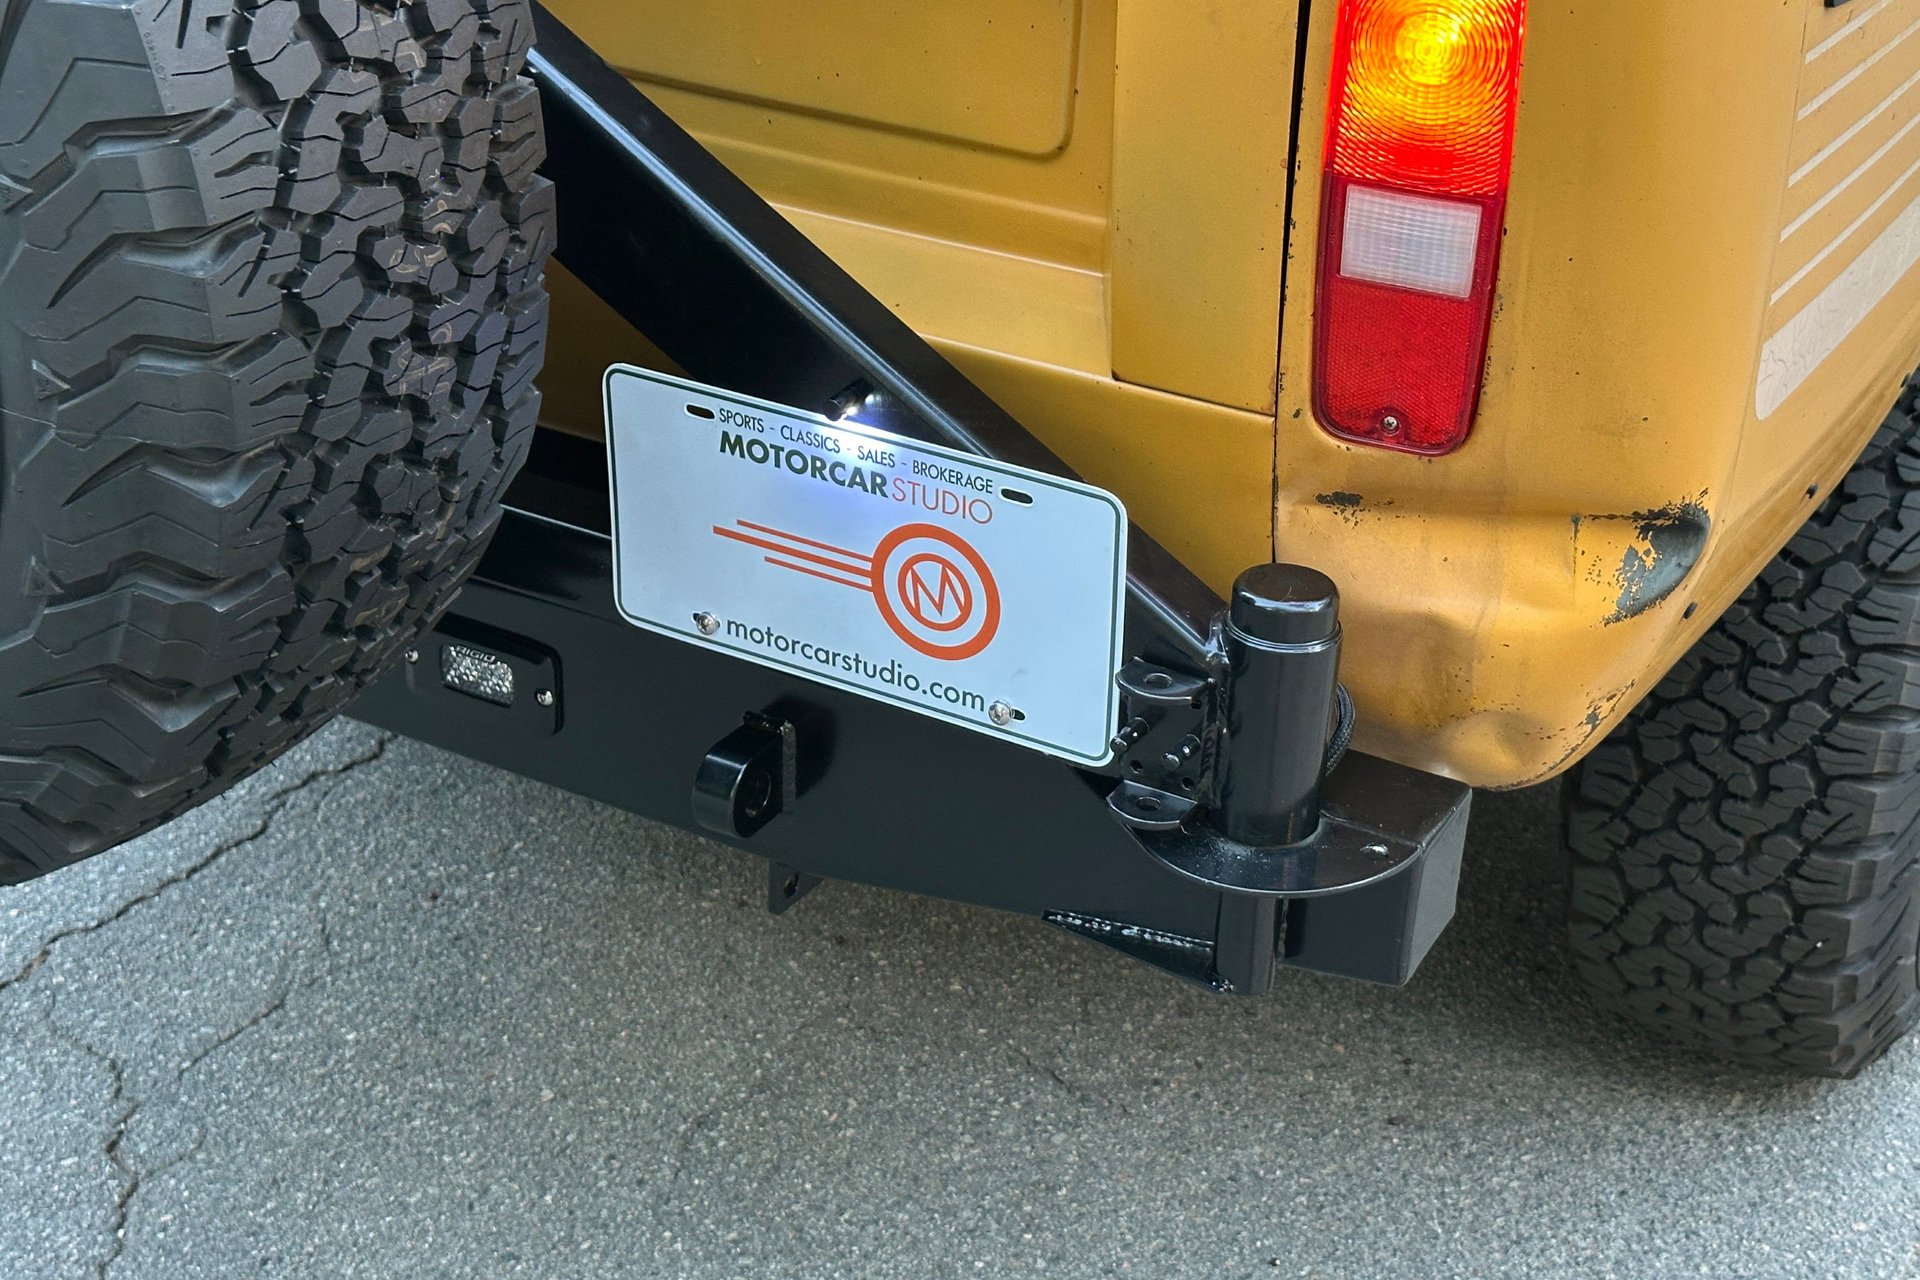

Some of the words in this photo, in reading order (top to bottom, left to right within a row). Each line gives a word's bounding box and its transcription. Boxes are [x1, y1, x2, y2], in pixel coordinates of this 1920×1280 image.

[719, 407, 765, 433] SPORTS
[780, 425, 841, 454] CLASSICS
[857, 446, 896, 468] SALES
[912, 459, 993, 494] BROKERAGE
[726, 619, 985, 712] motorcarstudio.com
